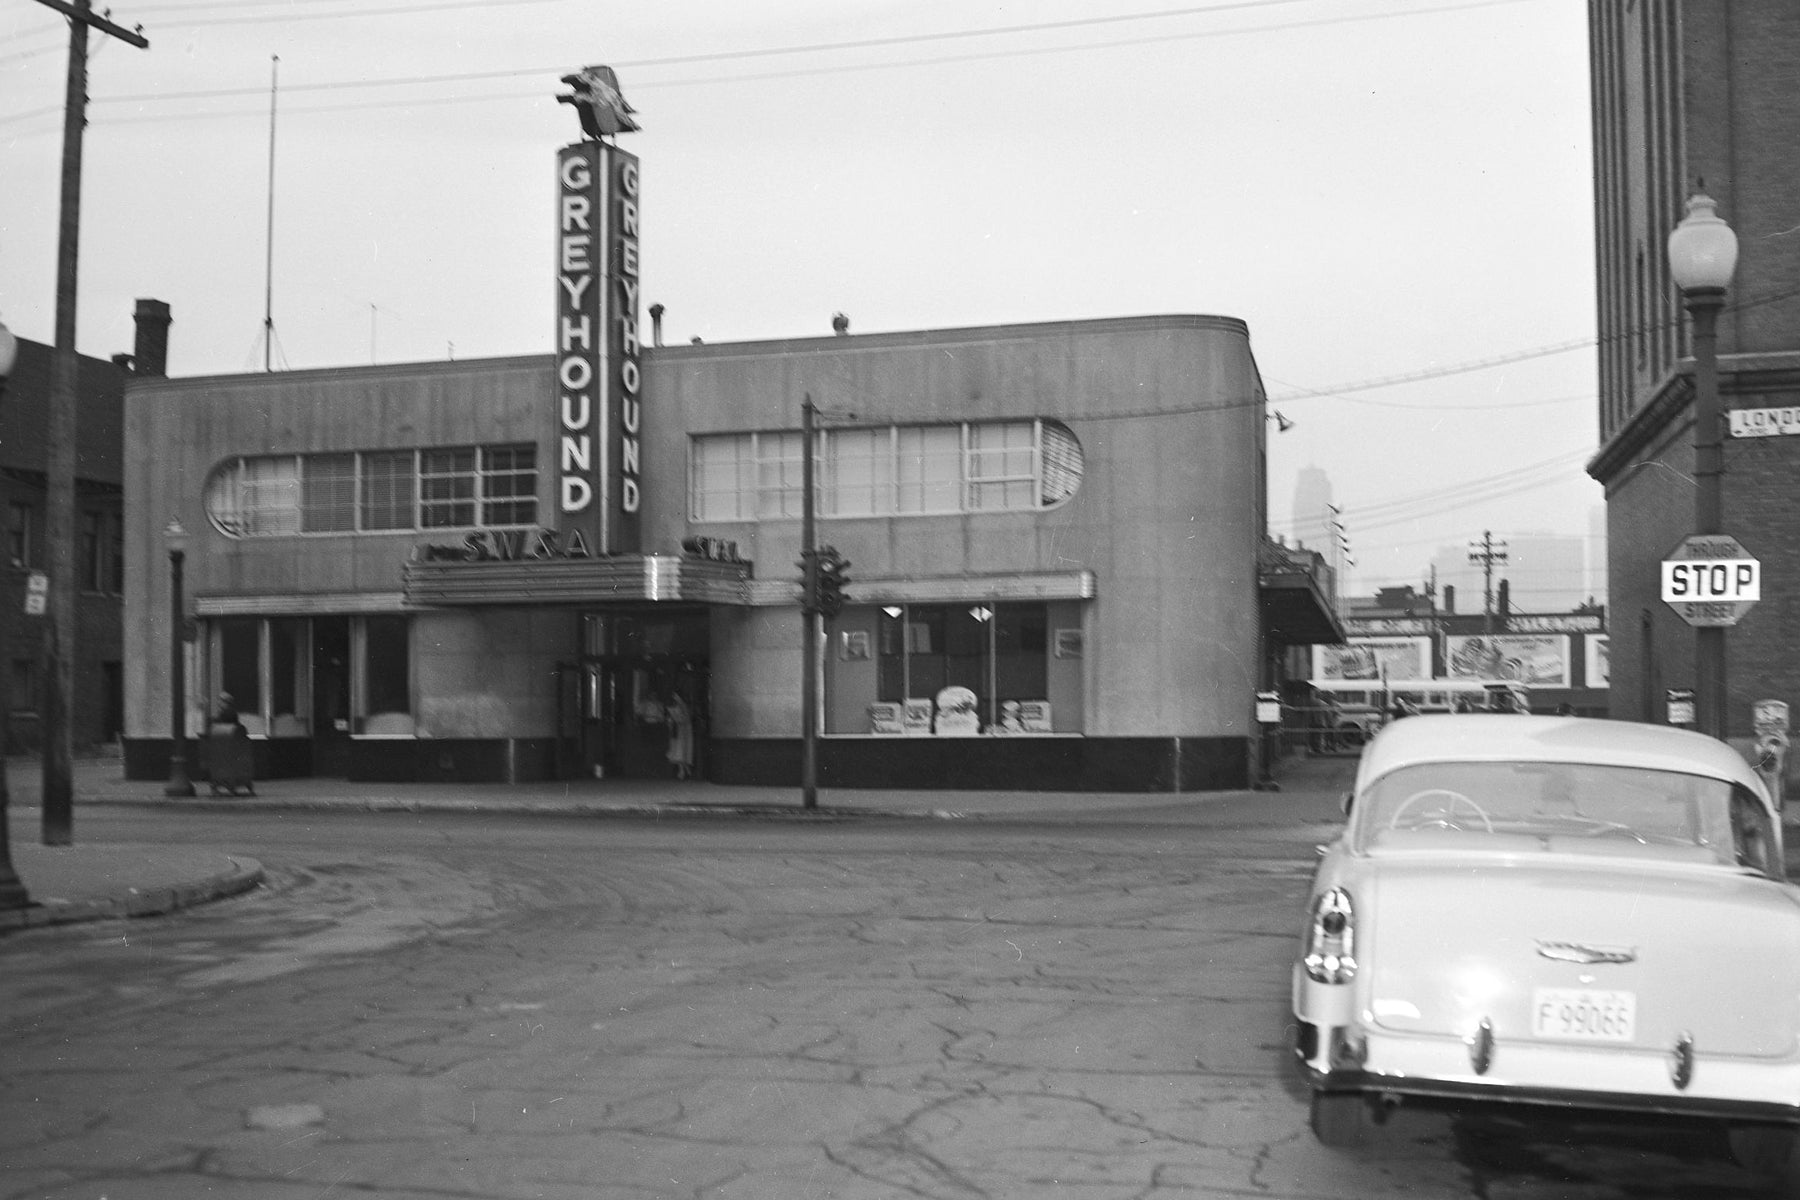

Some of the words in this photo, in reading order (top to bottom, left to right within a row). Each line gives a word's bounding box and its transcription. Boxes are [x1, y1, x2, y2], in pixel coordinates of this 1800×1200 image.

[559, 154, 593, 514] GREYHOUND
[622, 164, 640, 514] GREYHOUND
[1672, 564, 1753, 596] STOP
[1685, 602, 1736, 619] STREET
